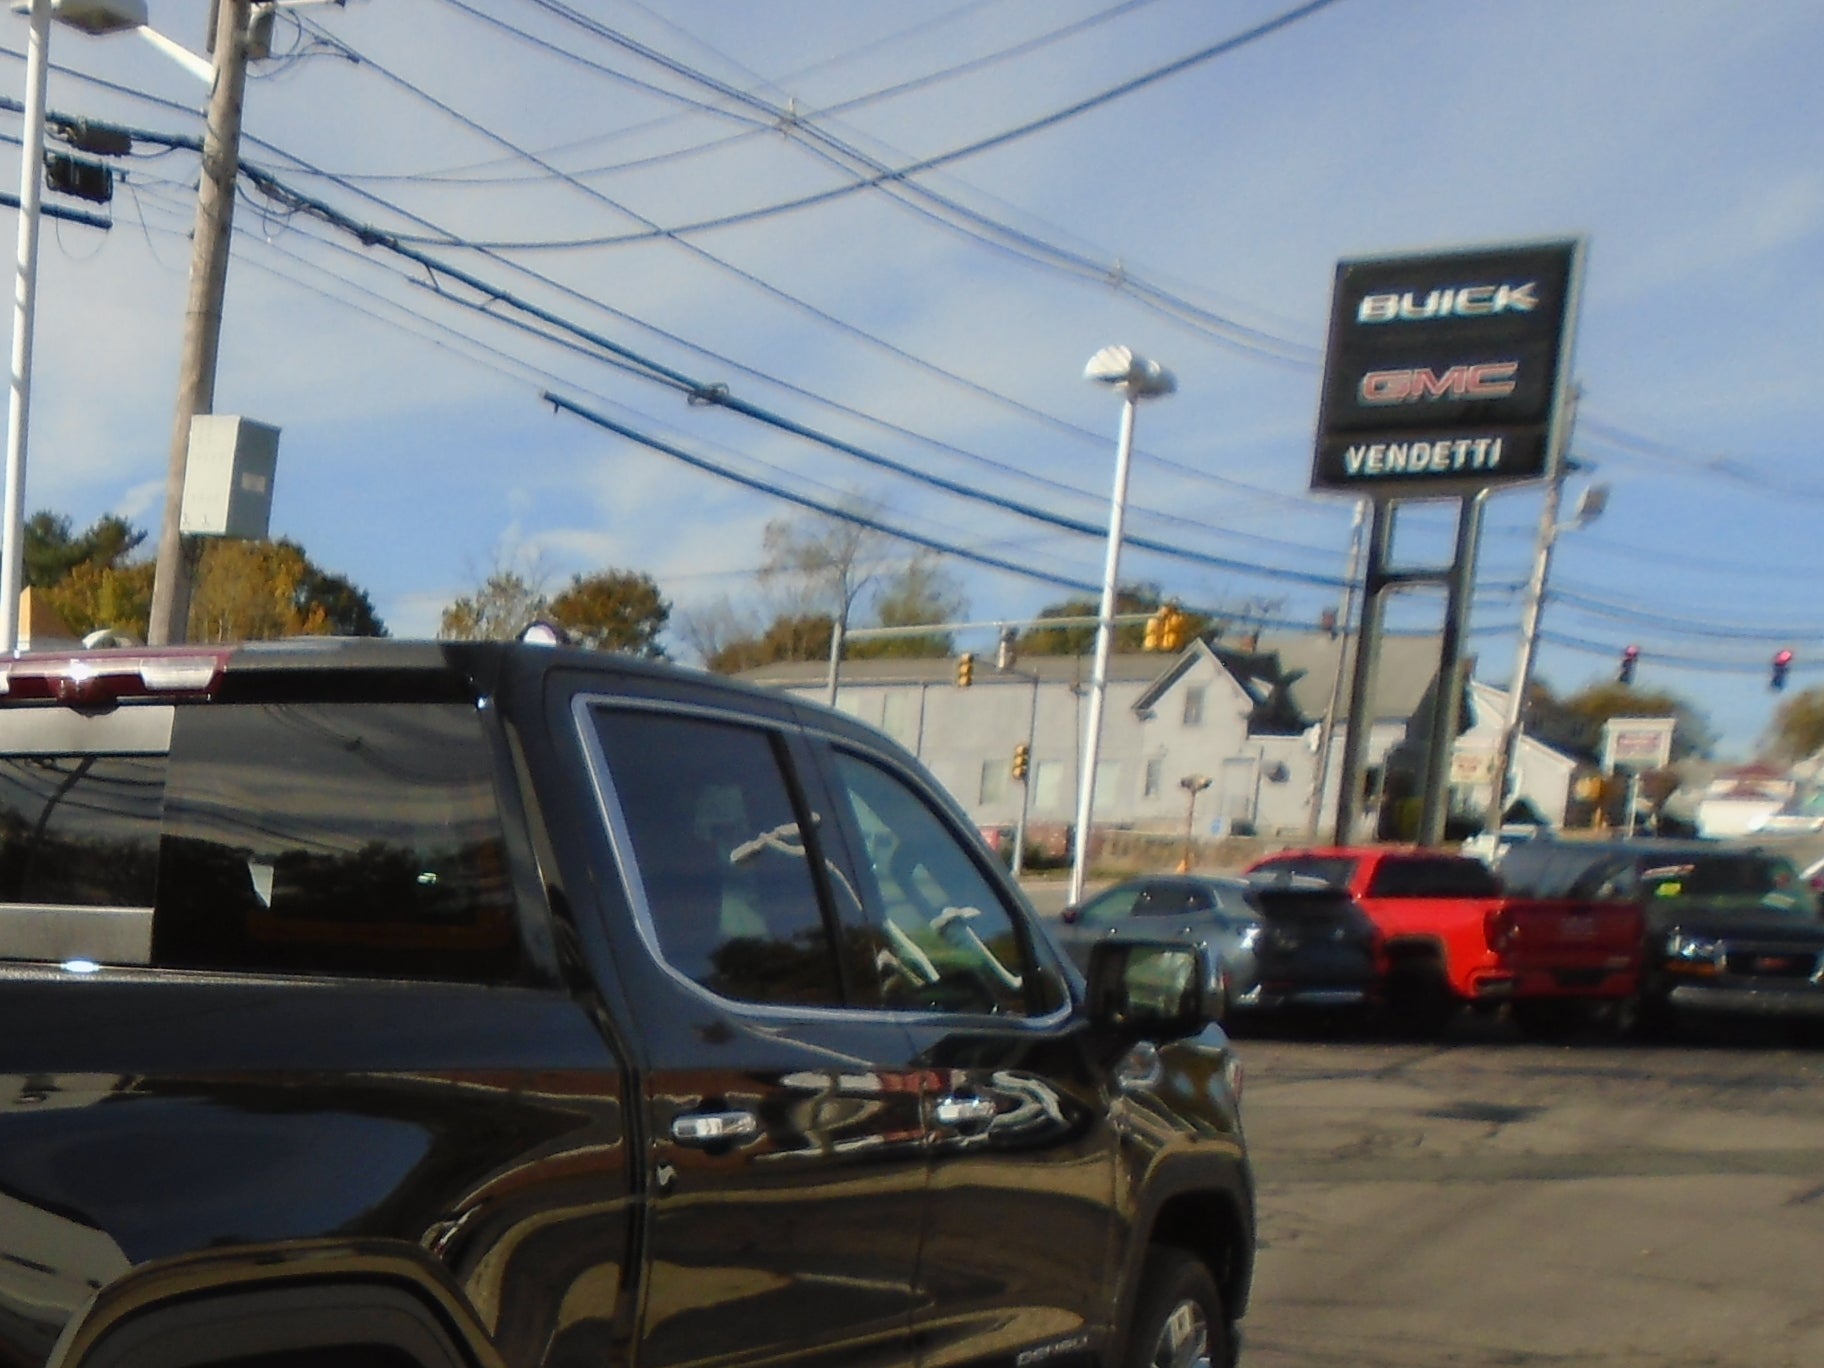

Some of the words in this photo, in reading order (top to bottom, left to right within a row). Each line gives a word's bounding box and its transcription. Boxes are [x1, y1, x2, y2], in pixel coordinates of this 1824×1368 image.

[1357, 282, 1541, 323] BUICK
[1358, 362, 1518, 404] GMC
[1346, 438, 1503, 475] VENDETTI
